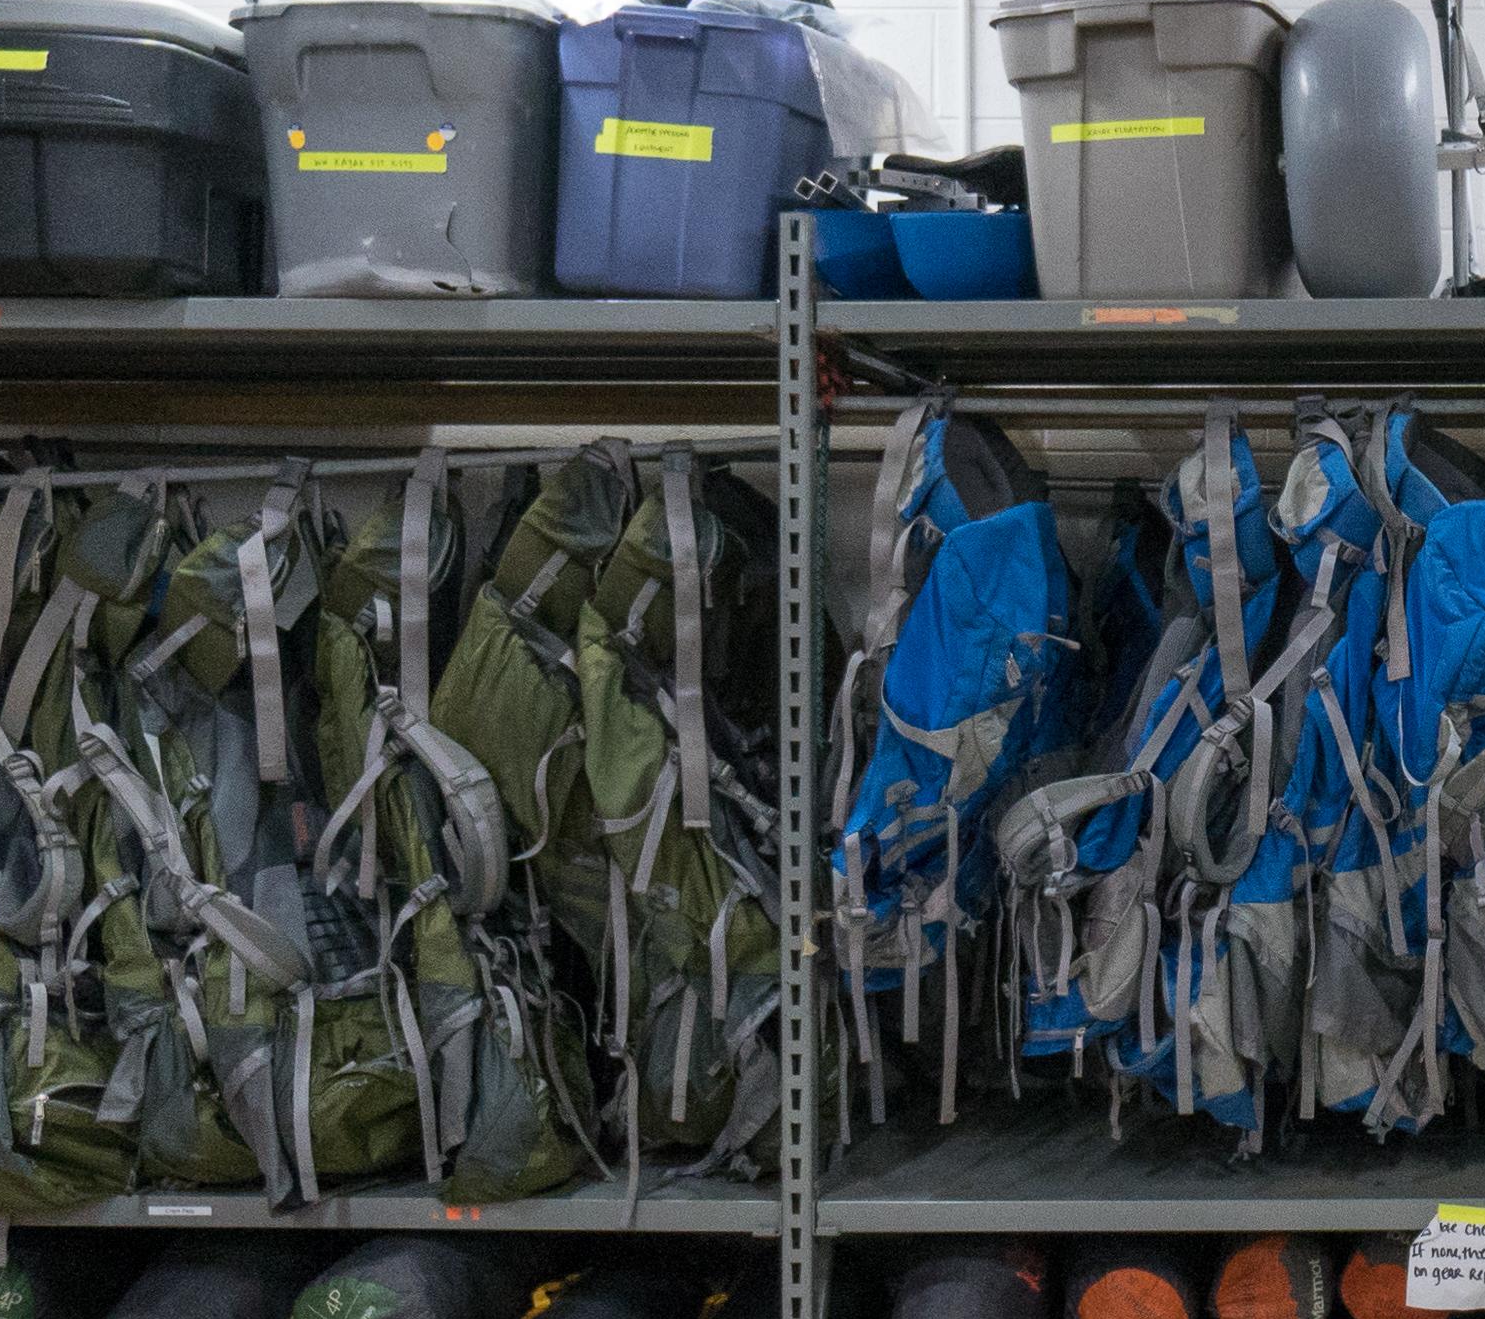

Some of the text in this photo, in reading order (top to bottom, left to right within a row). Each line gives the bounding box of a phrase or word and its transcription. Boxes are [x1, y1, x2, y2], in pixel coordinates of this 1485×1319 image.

[1411, 1242, 1425, 1258] If
[1414, 1265, 1428, 1278] on
[325, 1289, 343, 1316] 4P
